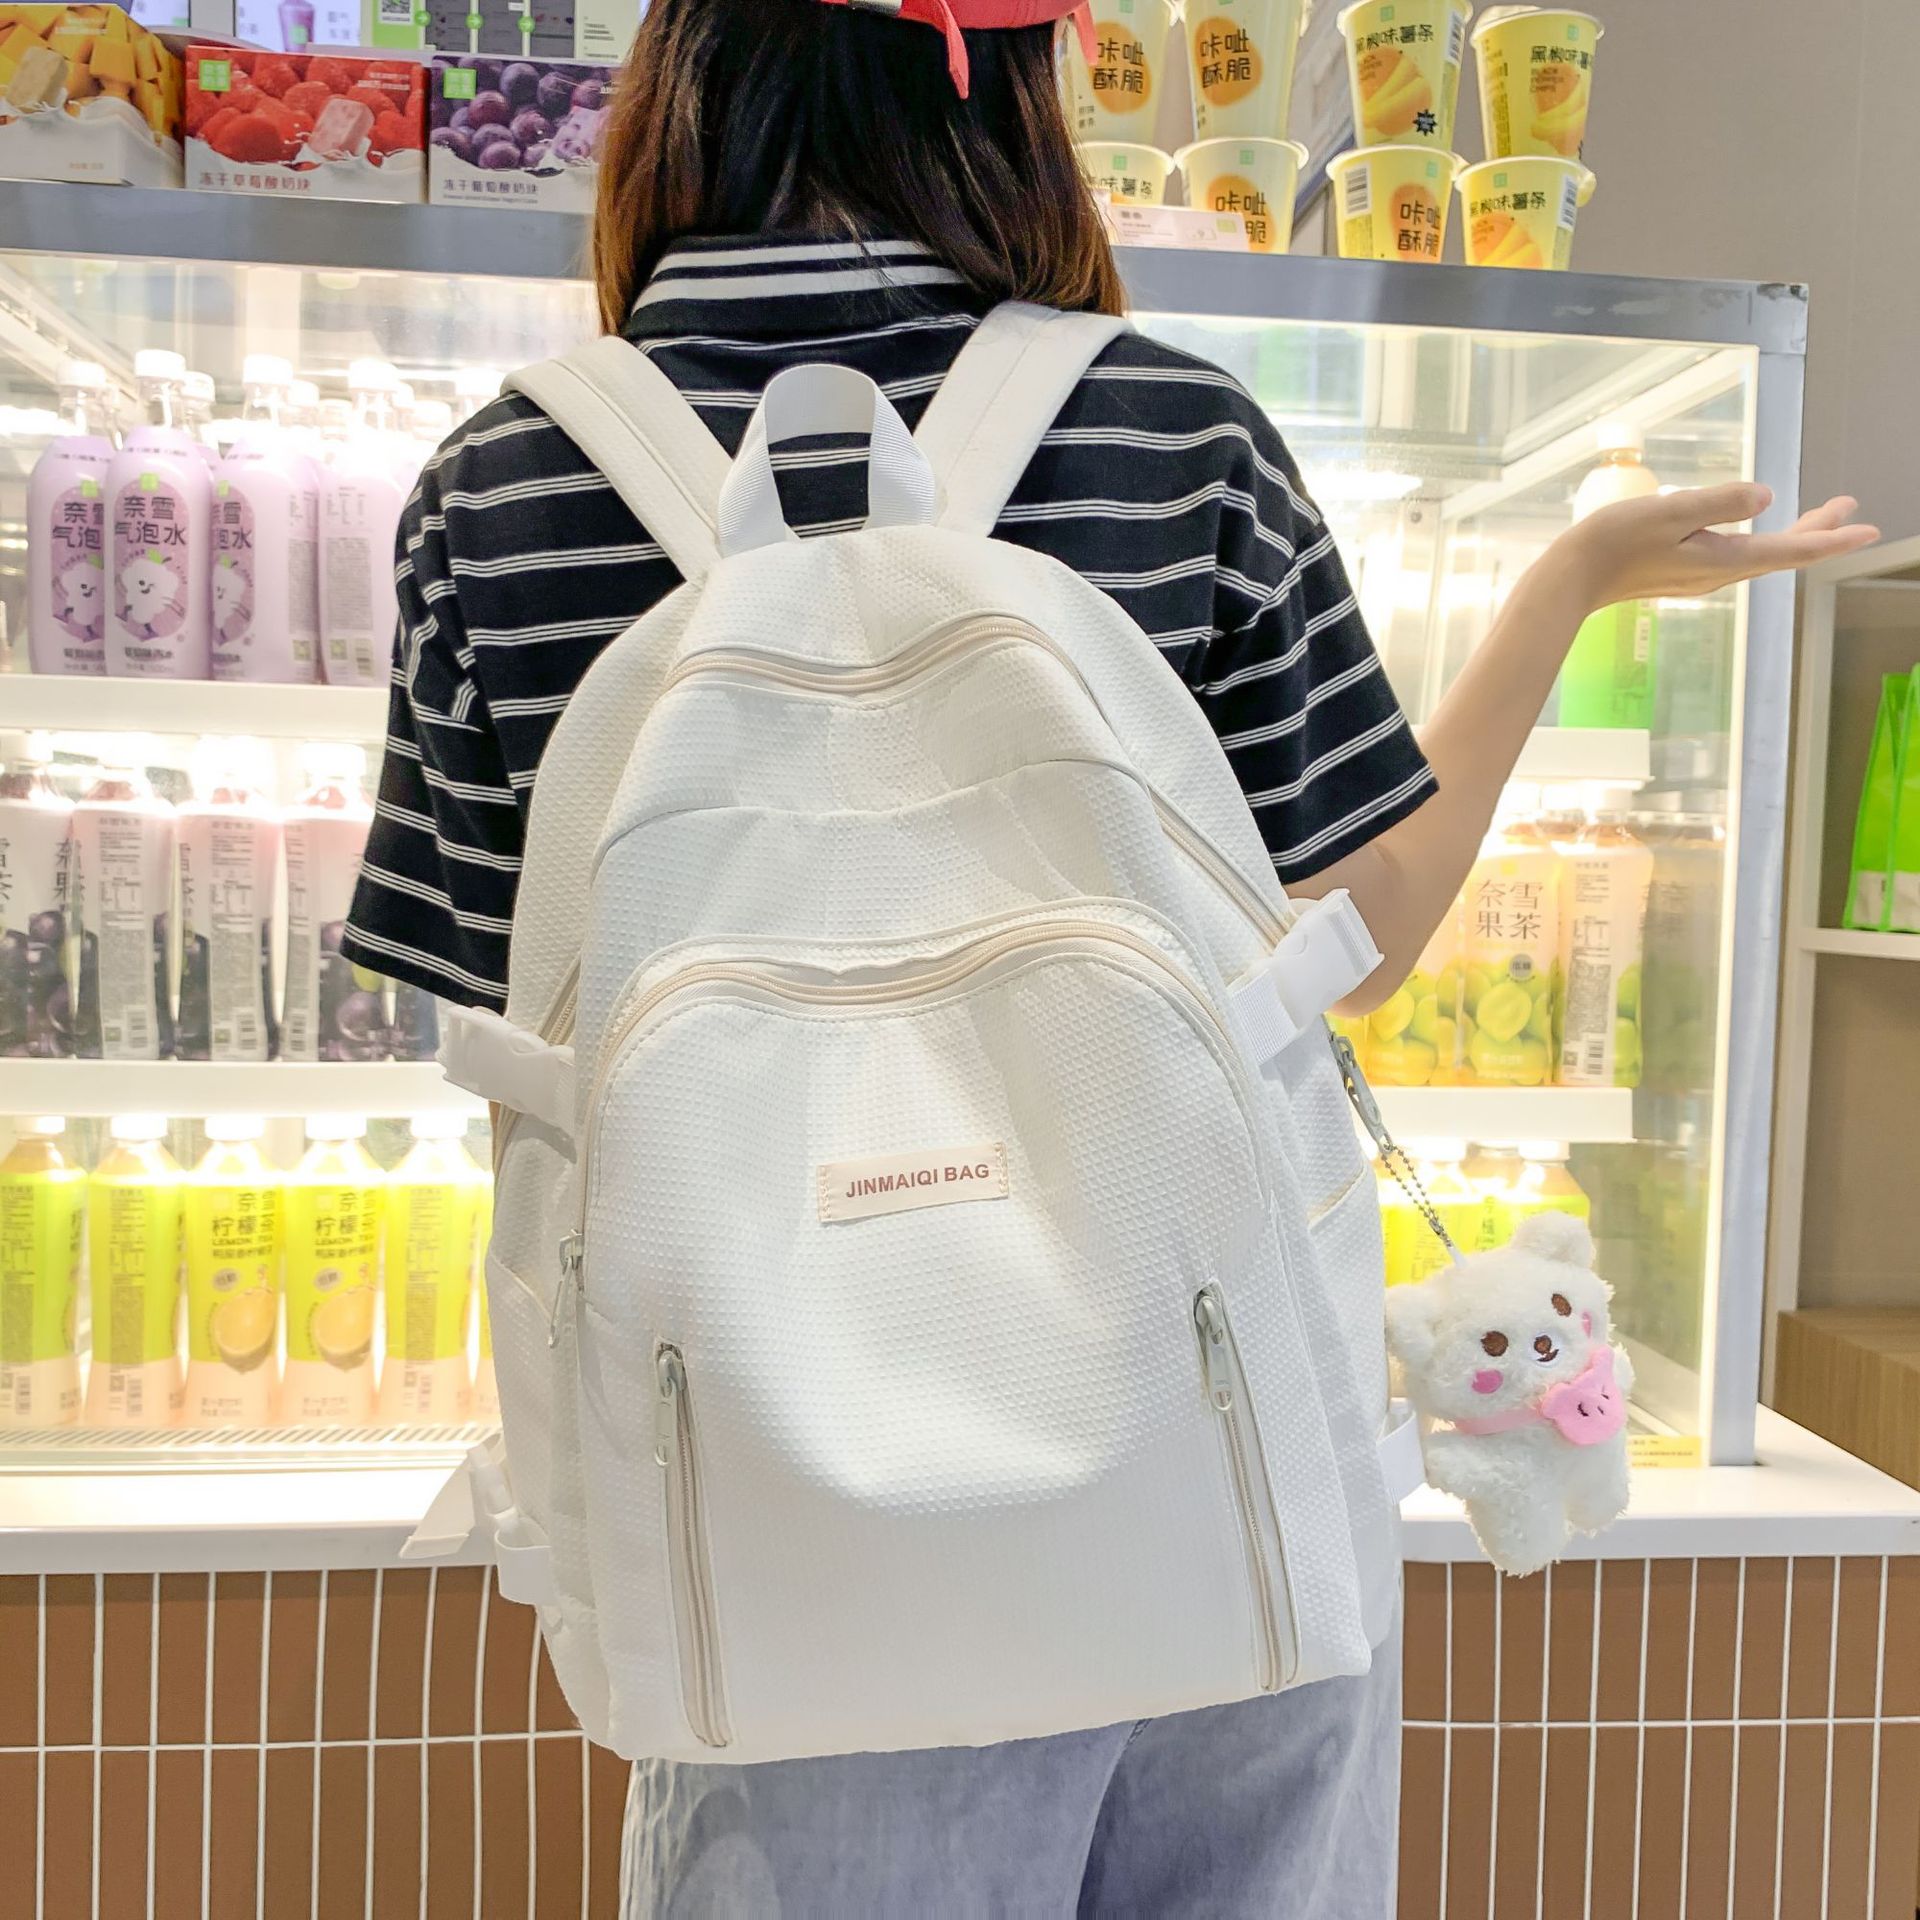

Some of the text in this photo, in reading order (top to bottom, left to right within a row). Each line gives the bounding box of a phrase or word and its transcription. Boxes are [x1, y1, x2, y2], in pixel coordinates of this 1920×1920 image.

[1096, 37, 1144, 66] 咔呲
[1201, 28, 1249, 59] 咔呲
[1356, 24, 1434, 52] 黑椒味薯条
[1093, 67, 1144, 94] 酥脆
[1202, 57, 1251, 88] 酥脆
[1092, 176, 1153, 199] 味薯条
[1215, 191, 1267, 216] 咔呲
[123, 495, 176, 521] 奈雪
[114, 521, 187, 546] 气泡水
[1476, 879, 1544, 910] 奈雪
[1475, 911, 1542, 940] 果茶
[846, 1163, 990, 1198] JINMAIQI BAG
